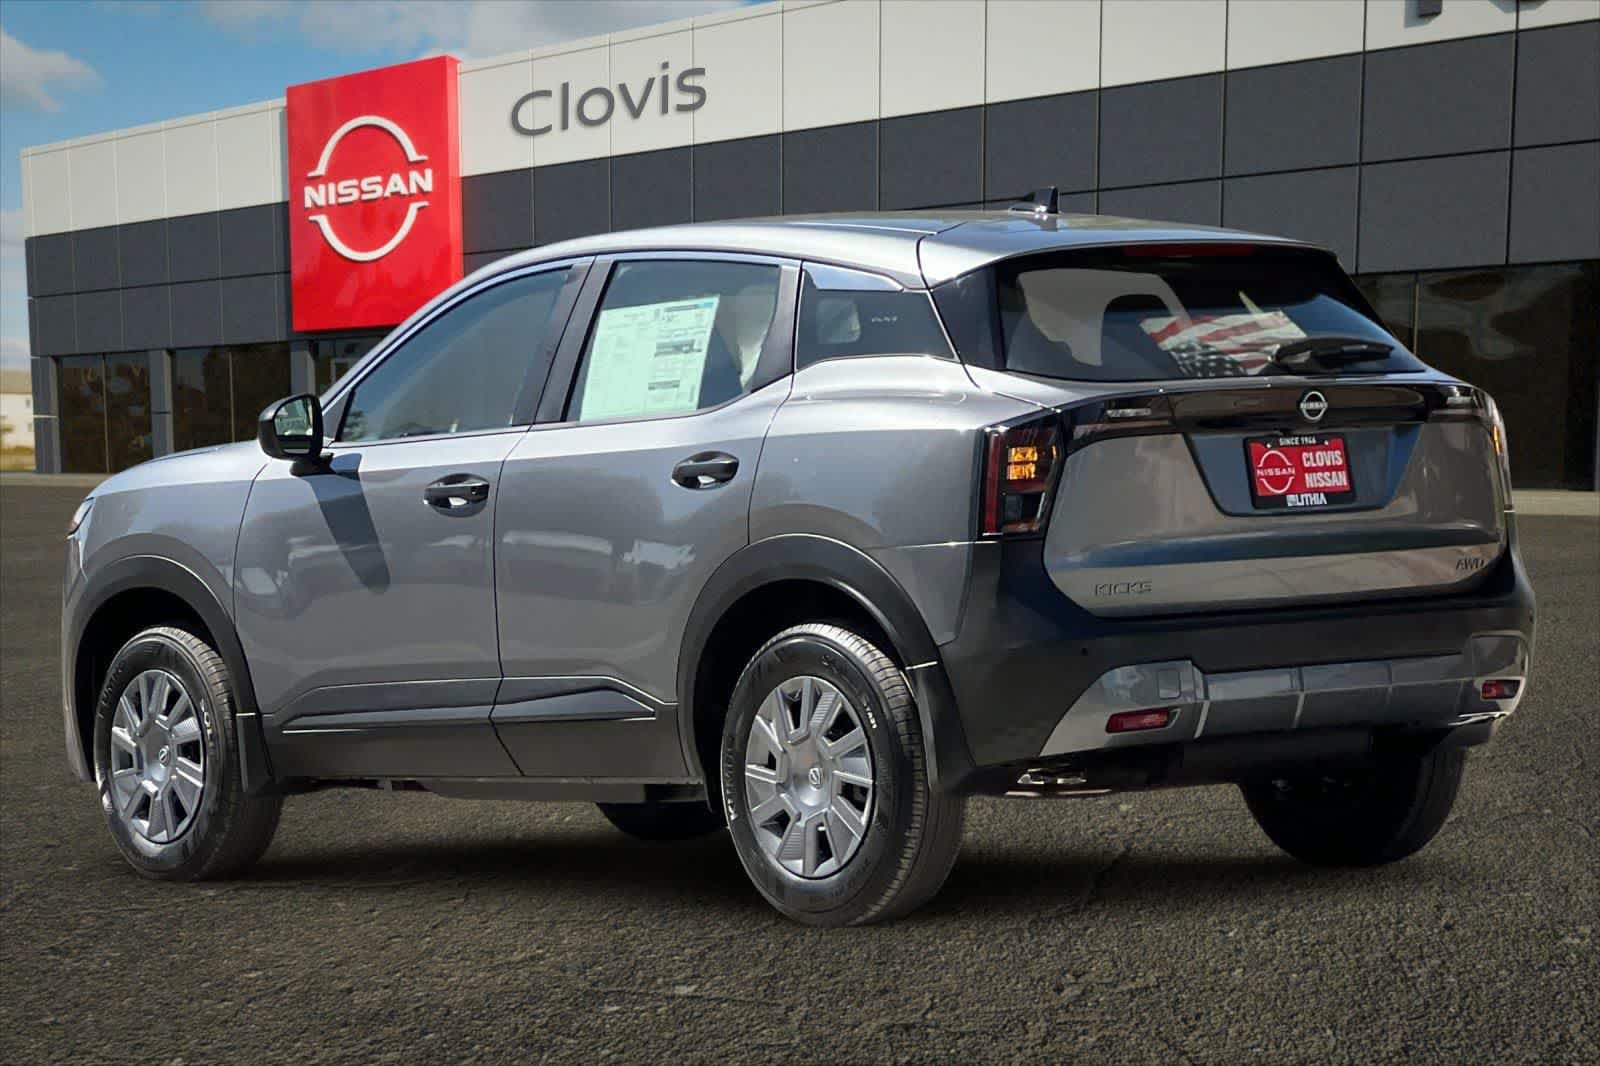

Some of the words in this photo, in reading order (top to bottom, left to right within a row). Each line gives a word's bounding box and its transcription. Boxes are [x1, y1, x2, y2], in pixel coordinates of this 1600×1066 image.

[511, 61, 707, 137] Clovis
[303, 168, 433, 209] NISSAN
[1279, 437, 1300, 446] SINCE
[1302, 450, 1343, 468] CLOVIS
[1256, 467, 1296, 477] NISSAN
[1304, 471, 1347, 488] NISSAN
[1296, 492, 1328, 506] LITHIA
[1095, 580, 1153, 596] KICKS
